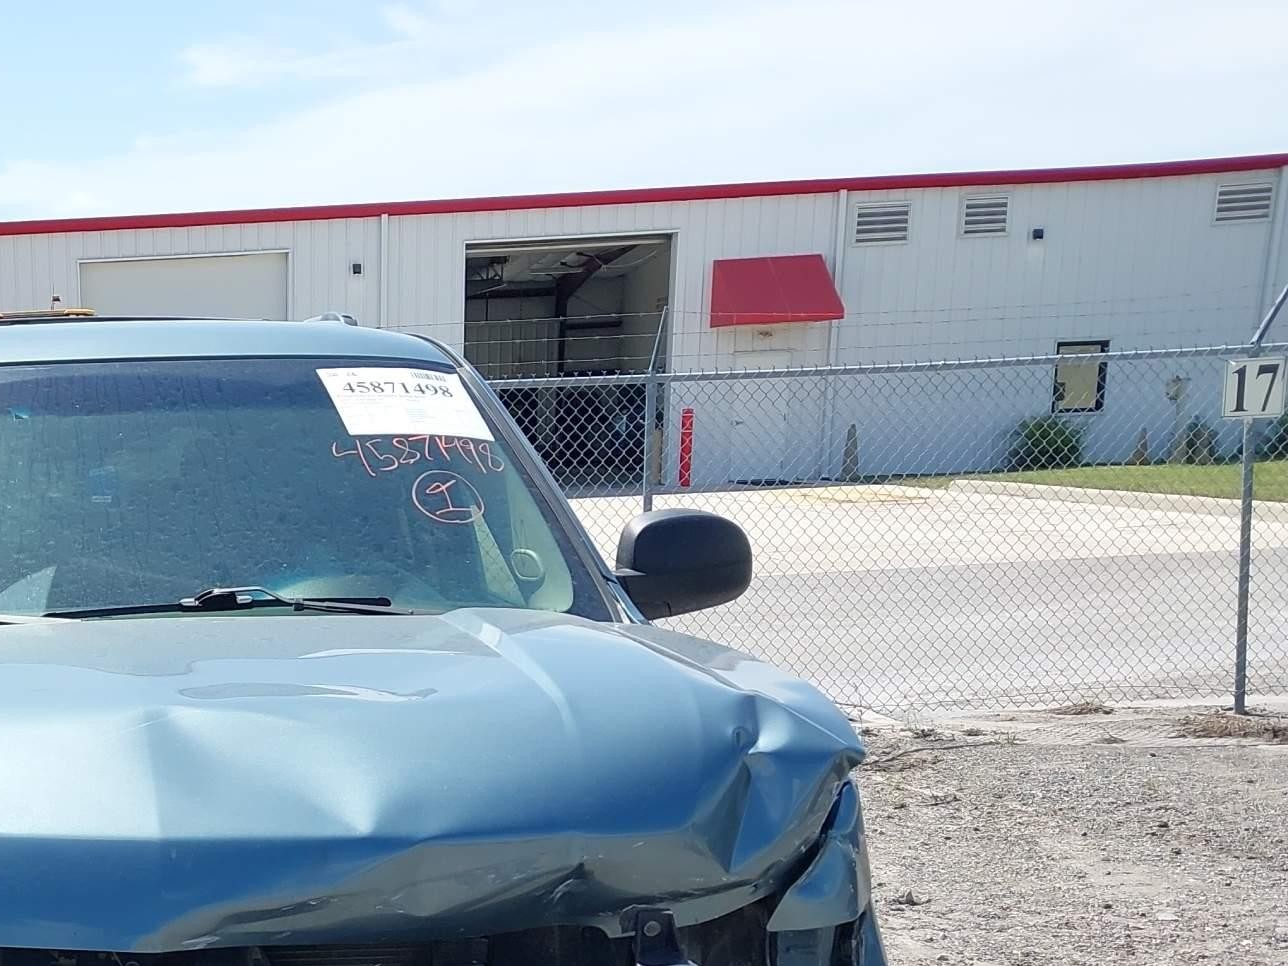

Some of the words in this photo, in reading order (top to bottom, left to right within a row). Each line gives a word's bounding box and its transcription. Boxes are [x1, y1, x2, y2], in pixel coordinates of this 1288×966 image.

[343, 380, 454, 398] 45871498
[1229, 363, 1280, 413] 17
[331, 434, 505, 477] 45871498
